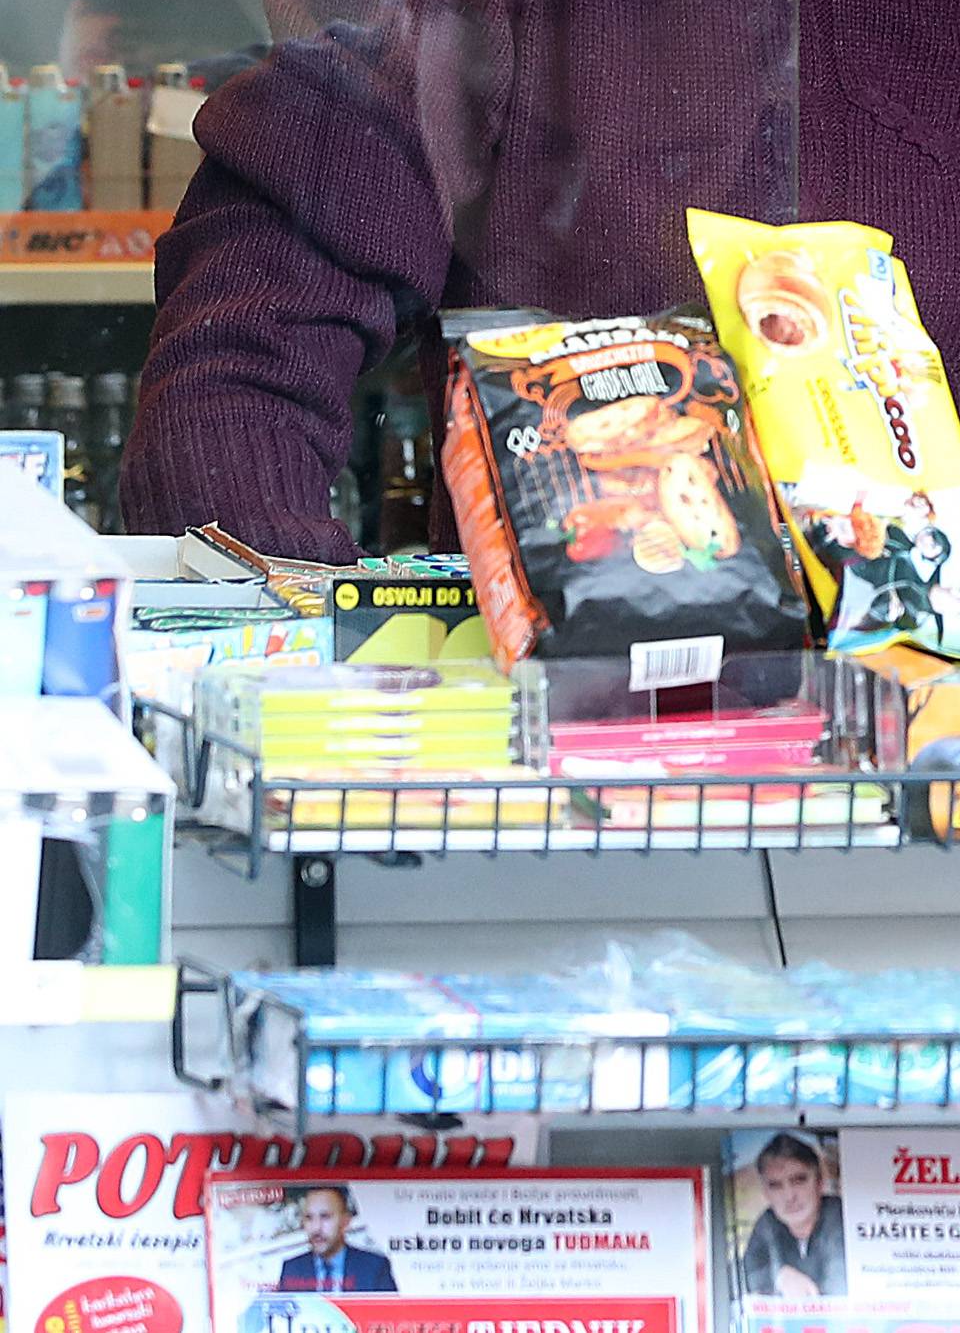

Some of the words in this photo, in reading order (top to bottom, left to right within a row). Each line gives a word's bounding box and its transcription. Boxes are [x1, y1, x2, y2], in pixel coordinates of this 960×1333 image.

[372, 586, 433, 607] OSVOJI
[435, 587, 461, 607] DO
[856, 1220, 930, 1240] SJAŠITE
